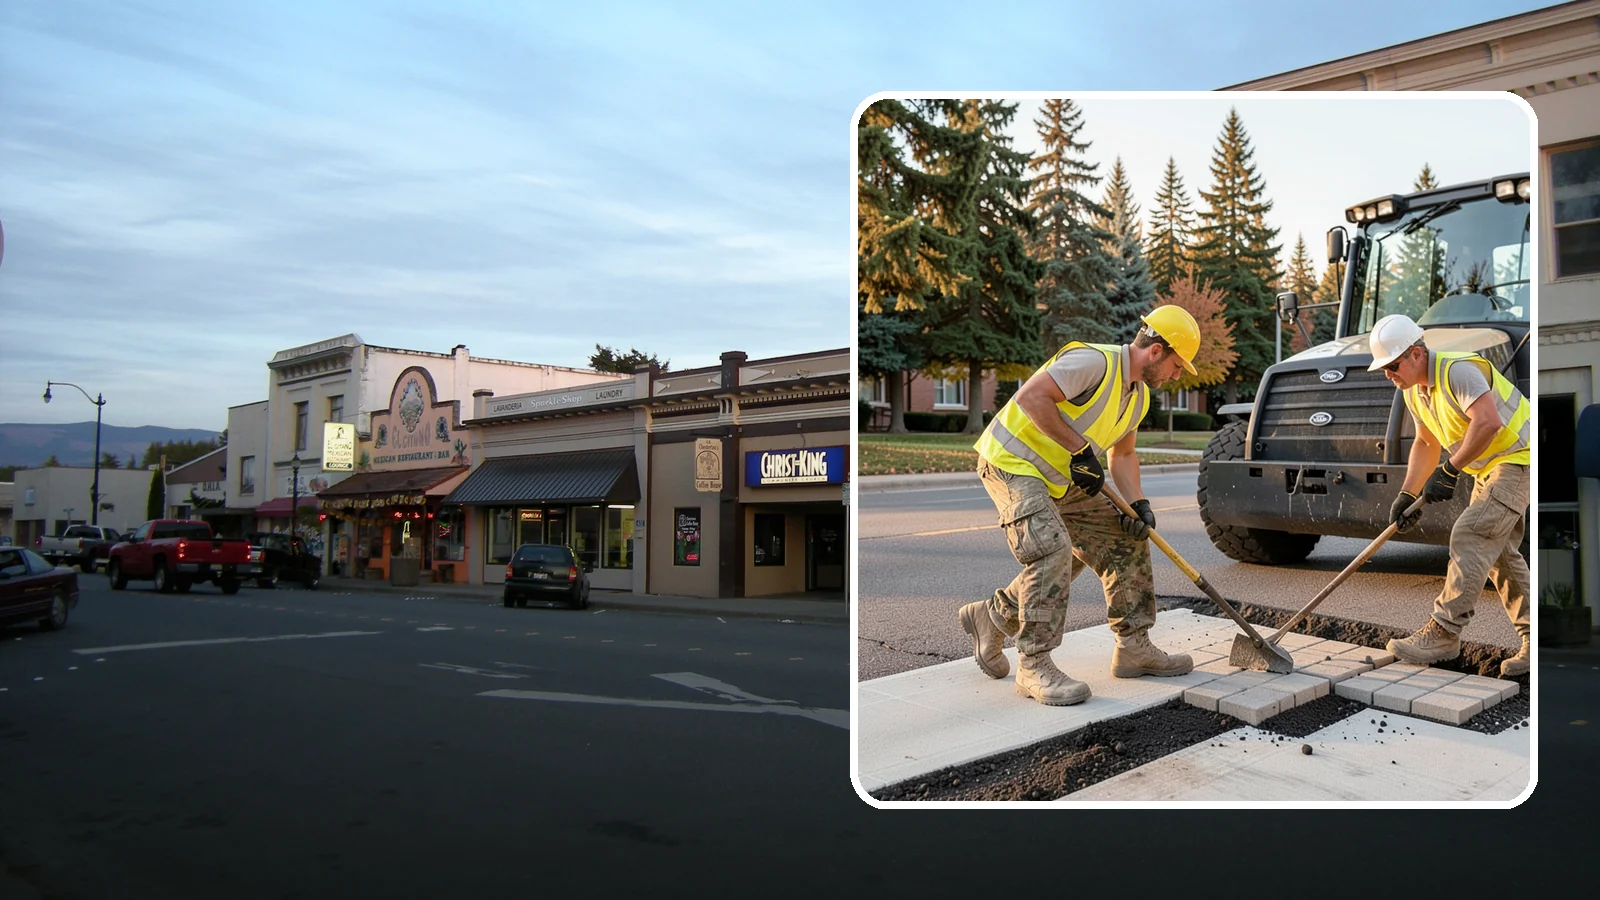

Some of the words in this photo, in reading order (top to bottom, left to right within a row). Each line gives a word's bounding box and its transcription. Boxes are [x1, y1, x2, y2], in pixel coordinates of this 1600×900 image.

[530, 397, 561, 409] Sparkle
[562, 394, 583, 405] Shop
[595, 389, 624, 400] LAUNDRY
[493, 402, 523, 413] LAVANDERIA
[373, 455, 396, 464] MEXICAN
[397, 451, 434, 462] RESTAURANT
[438, 450, 450, 459] BAR
[761, 452, 797, 478] CHRIST
[799, 450, 827, 477] KING
